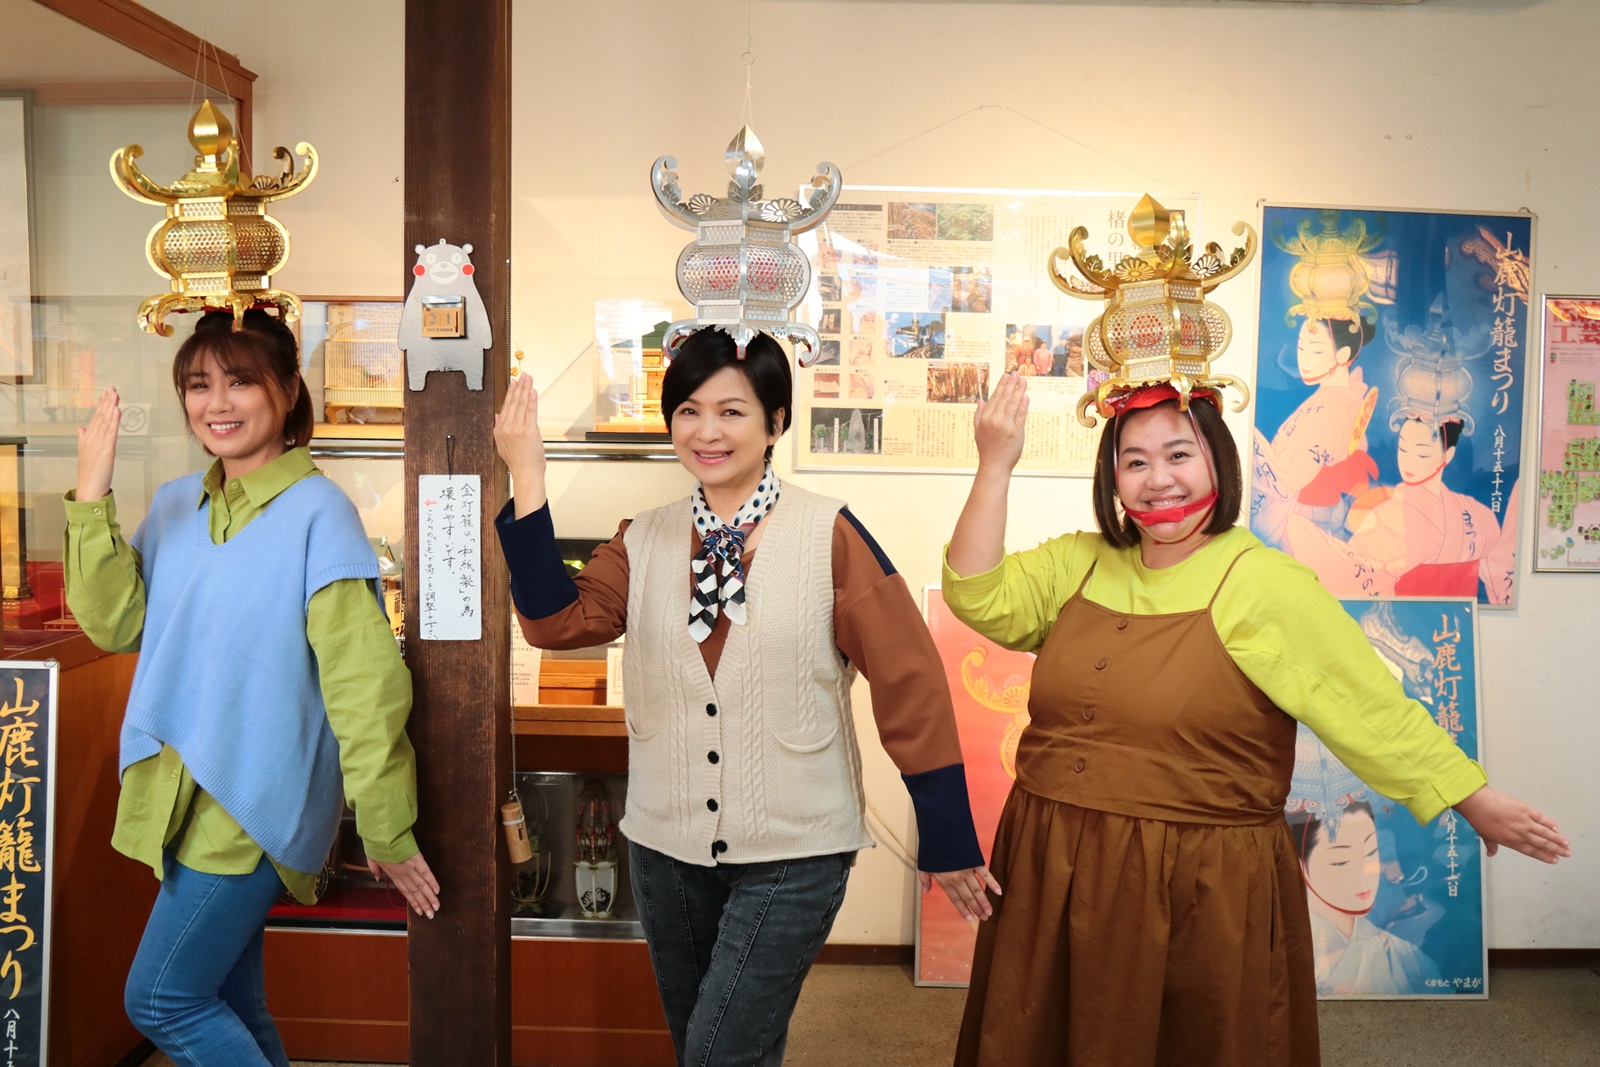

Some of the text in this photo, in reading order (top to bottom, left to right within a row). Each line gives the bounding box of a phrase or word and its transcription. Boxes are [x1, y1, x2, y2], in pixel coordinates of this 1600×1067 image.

[1488, 231, 1523, 415] 山鹿灯籠まつり
[1491, 424, 1506, 513] 八月十五・十六日
[1462, 510, 1477, 558] まつり
[0, 677, 41, 1000] 山鹿灯籠まつり
[1446, 809, 1459, 897] 八月十五・十六日
[1424, 976, 1482, 989] くまもと やまが
